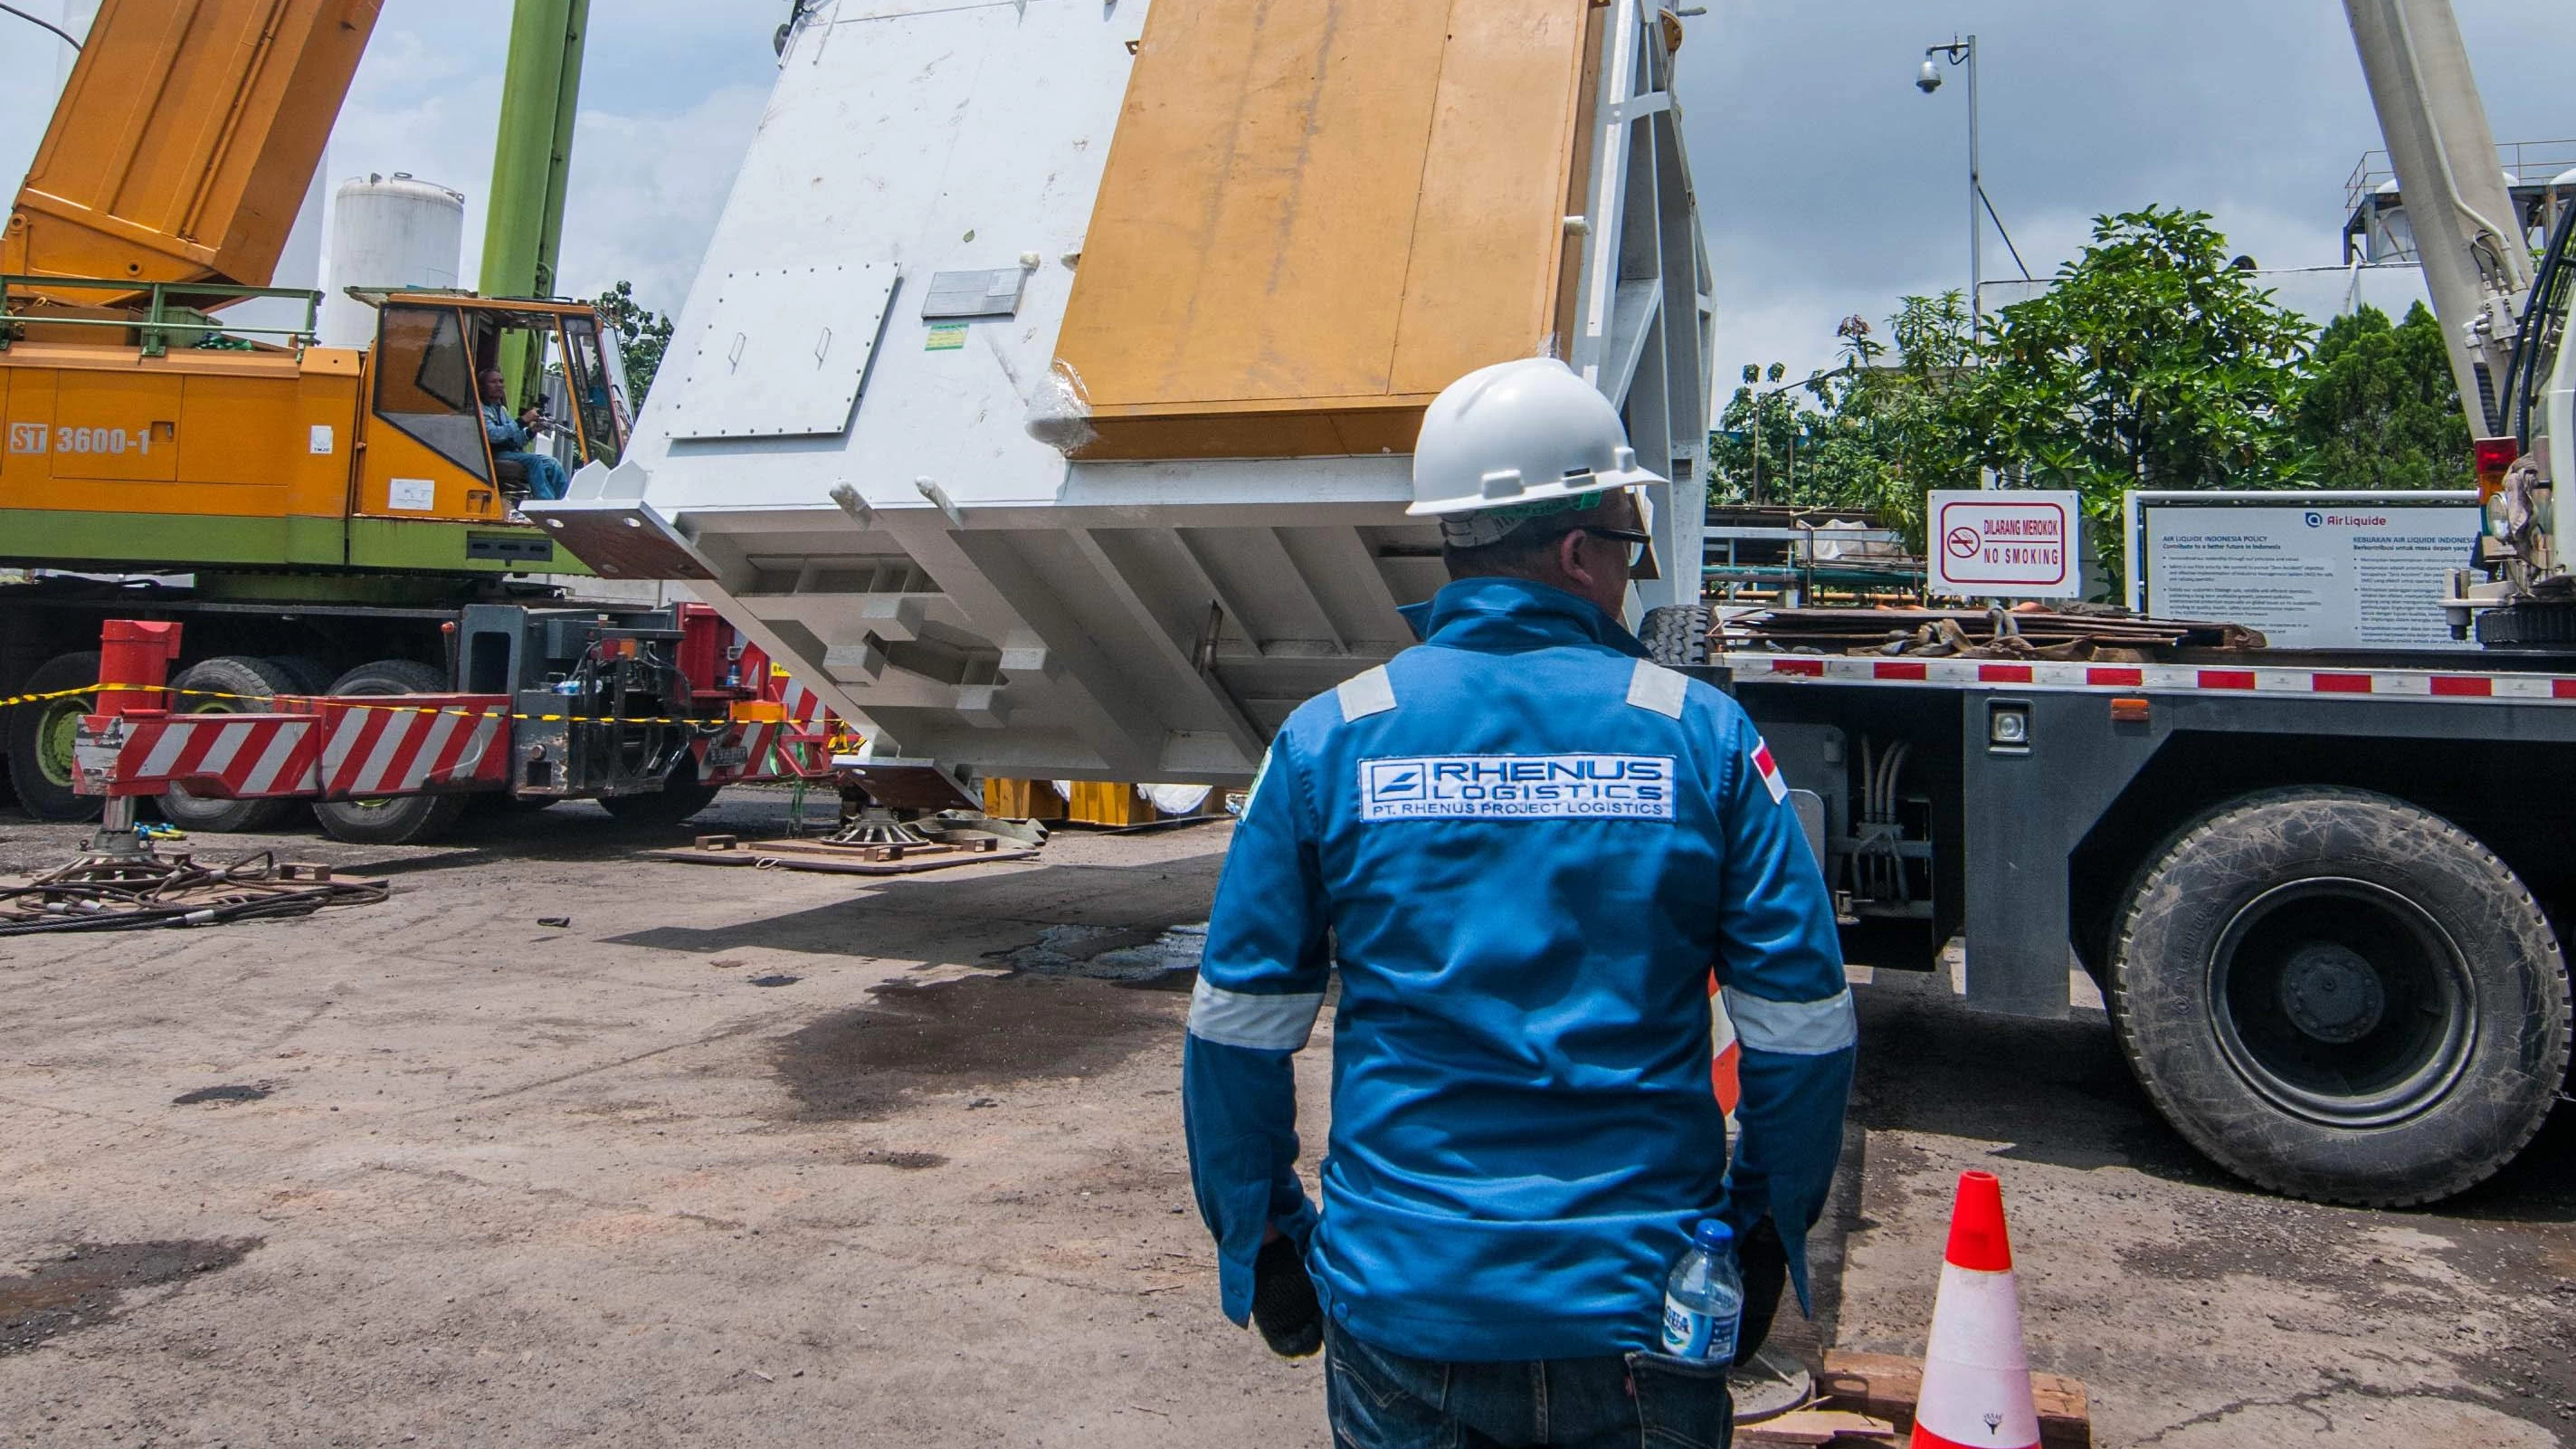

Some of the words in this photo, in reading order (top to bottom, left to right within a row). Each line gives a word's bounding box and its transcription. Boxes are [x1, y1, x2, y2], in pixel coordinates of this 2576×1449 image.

[12, 424, 46, 452] ST
[56, 426, 150, 454] 3600-1
[1983, 520, 2020, 536] DILARANG
[2022, 520, 2058, 536] MEROKOK
[1984, 548, 1999, 564] NO
[2005, 548, 2058, 565] SMOKING
[1433, 760, 1662, 782] RHENUS
[1433, 784, 1663, 801] LOGISTICS
[1373, 805, 1397, 815] PT.
[1402, 802, 1476, 815] RHENUS
[1480, 802, 1559, 815] PROJECT
[1567, 802, 1663, 815] LOGISTICS
